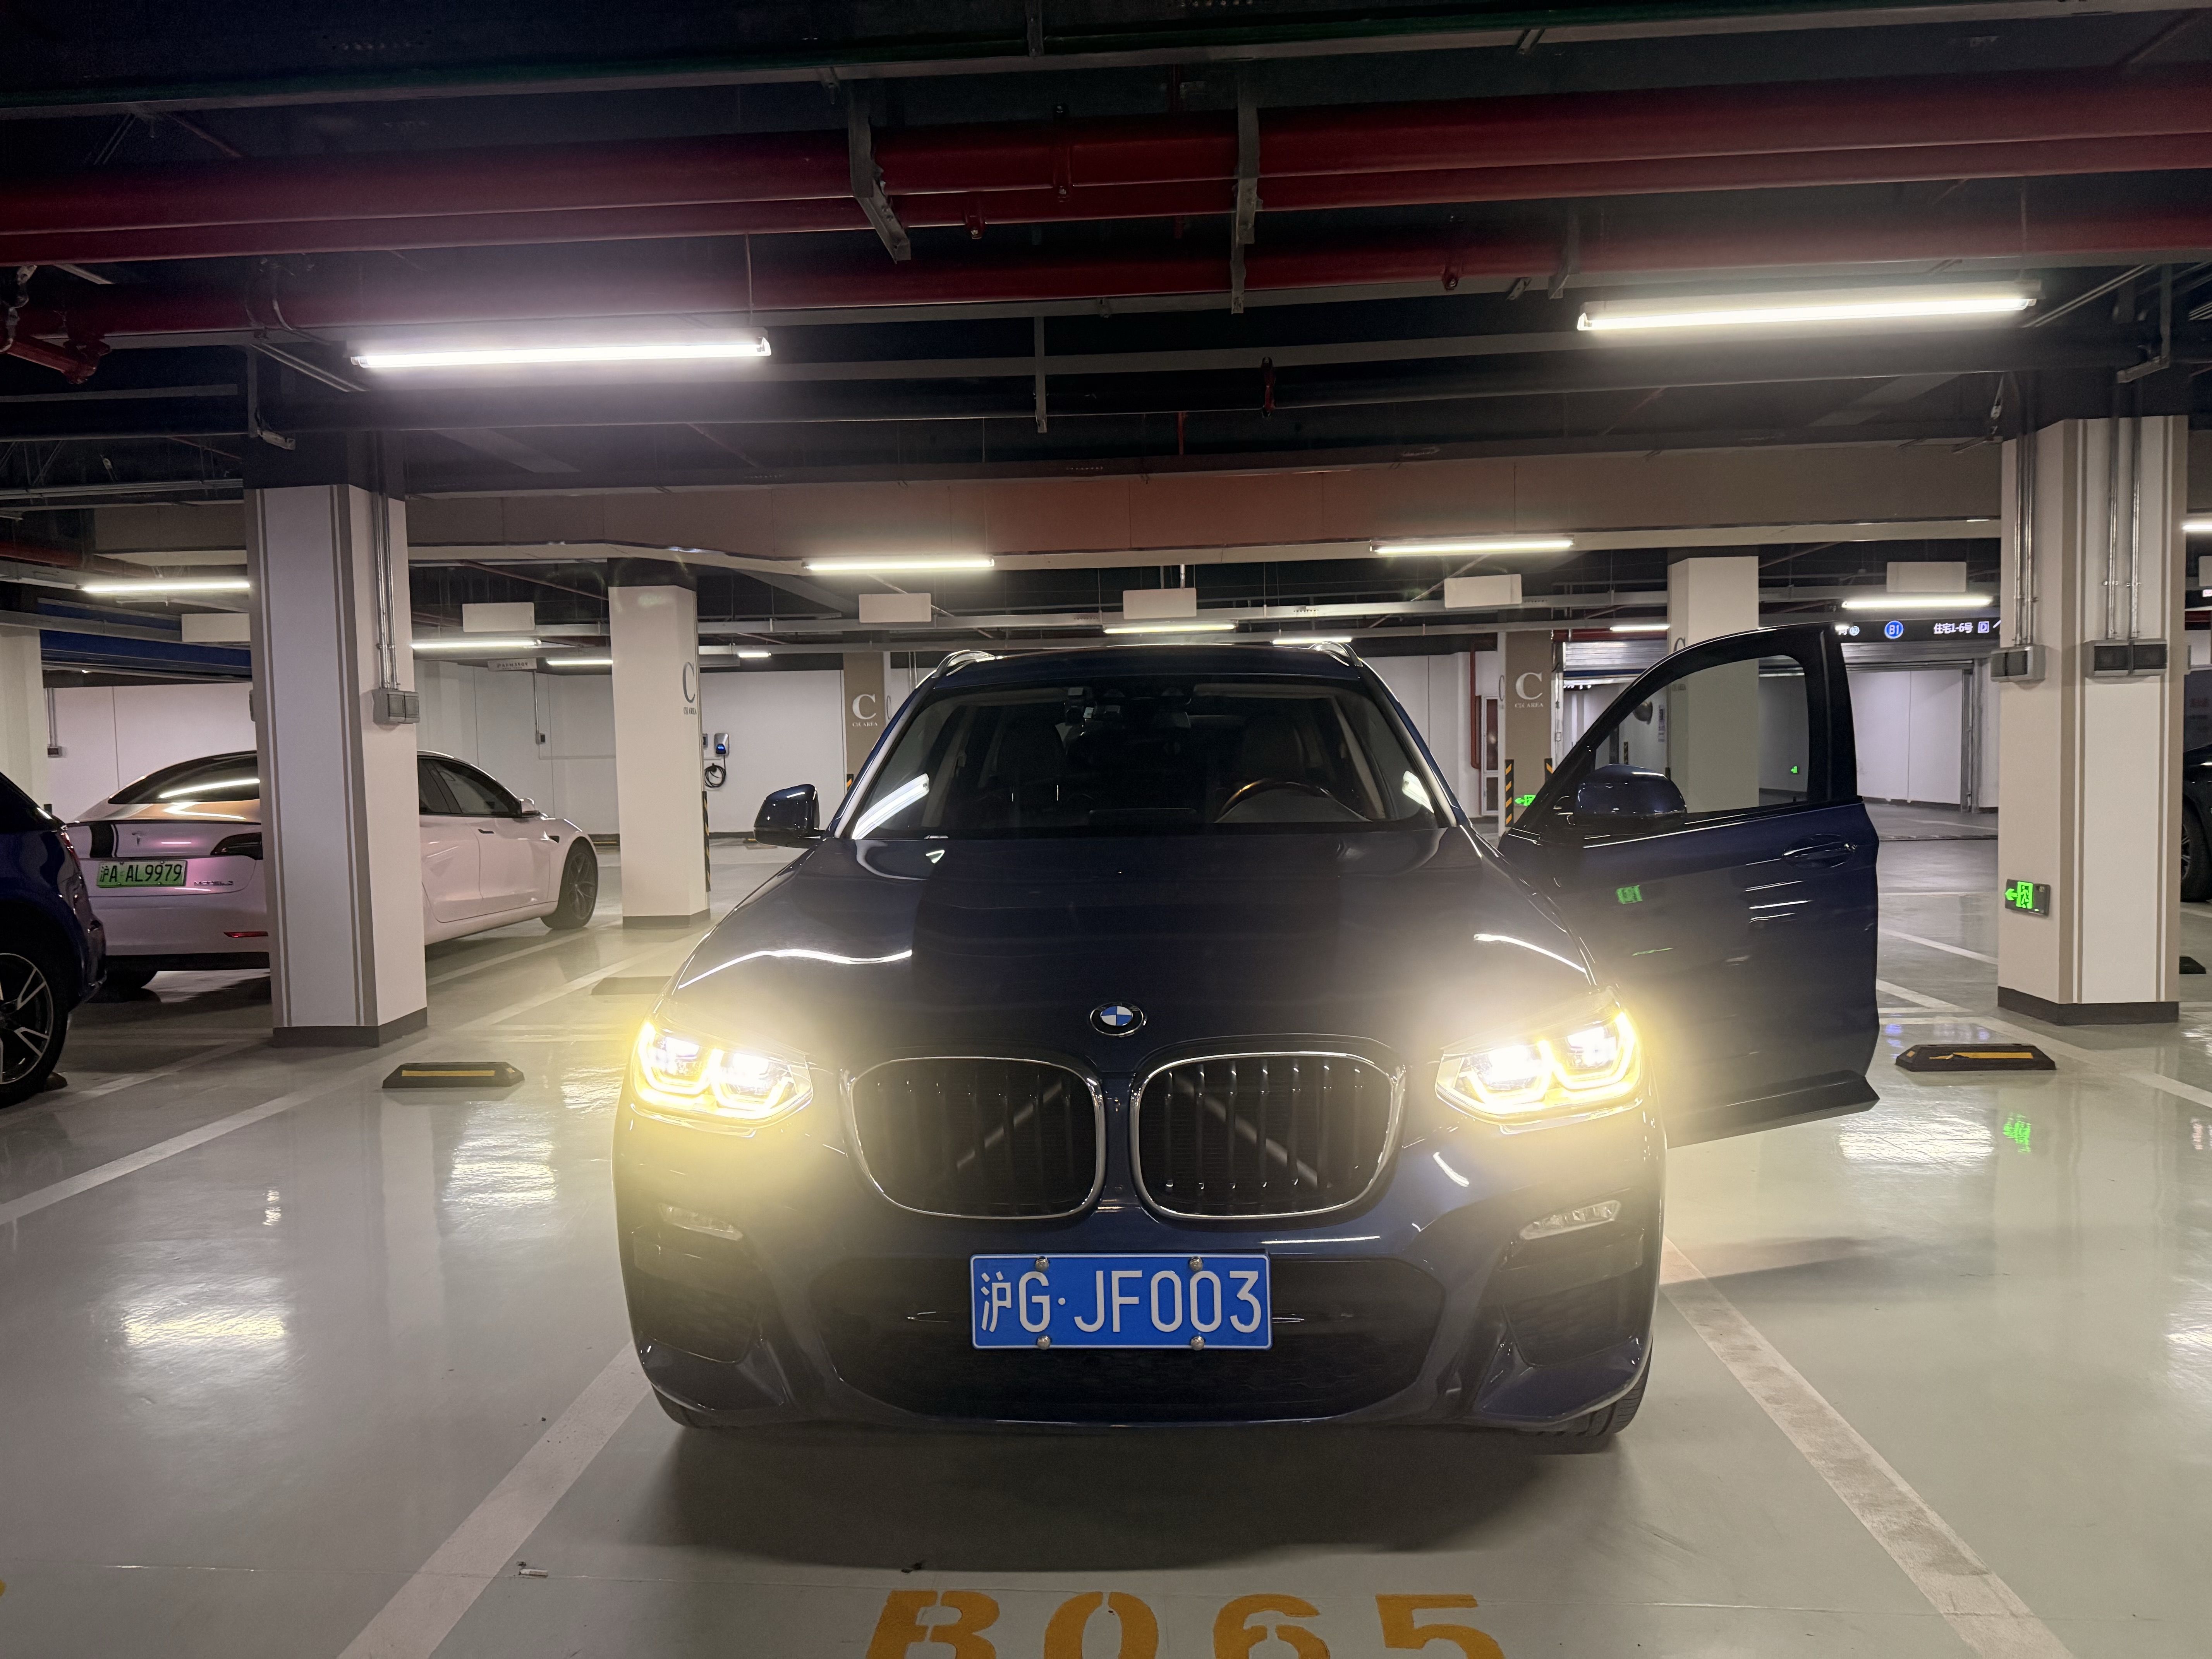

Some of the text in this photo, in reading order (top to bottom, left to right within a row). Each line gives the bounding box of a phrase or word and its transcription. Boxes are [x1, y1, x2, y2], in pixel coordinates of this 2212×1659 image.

[1889, 624, 1899, 635] B1
[1934, 622, 1973, 634] 住宅1-6号
[682, 661, 696, 703] C
[1516, 672, 1543, 700] C
[852, 694, 876, 720] C
[981, 1270, 1261, 1333] 沪G·JF003
